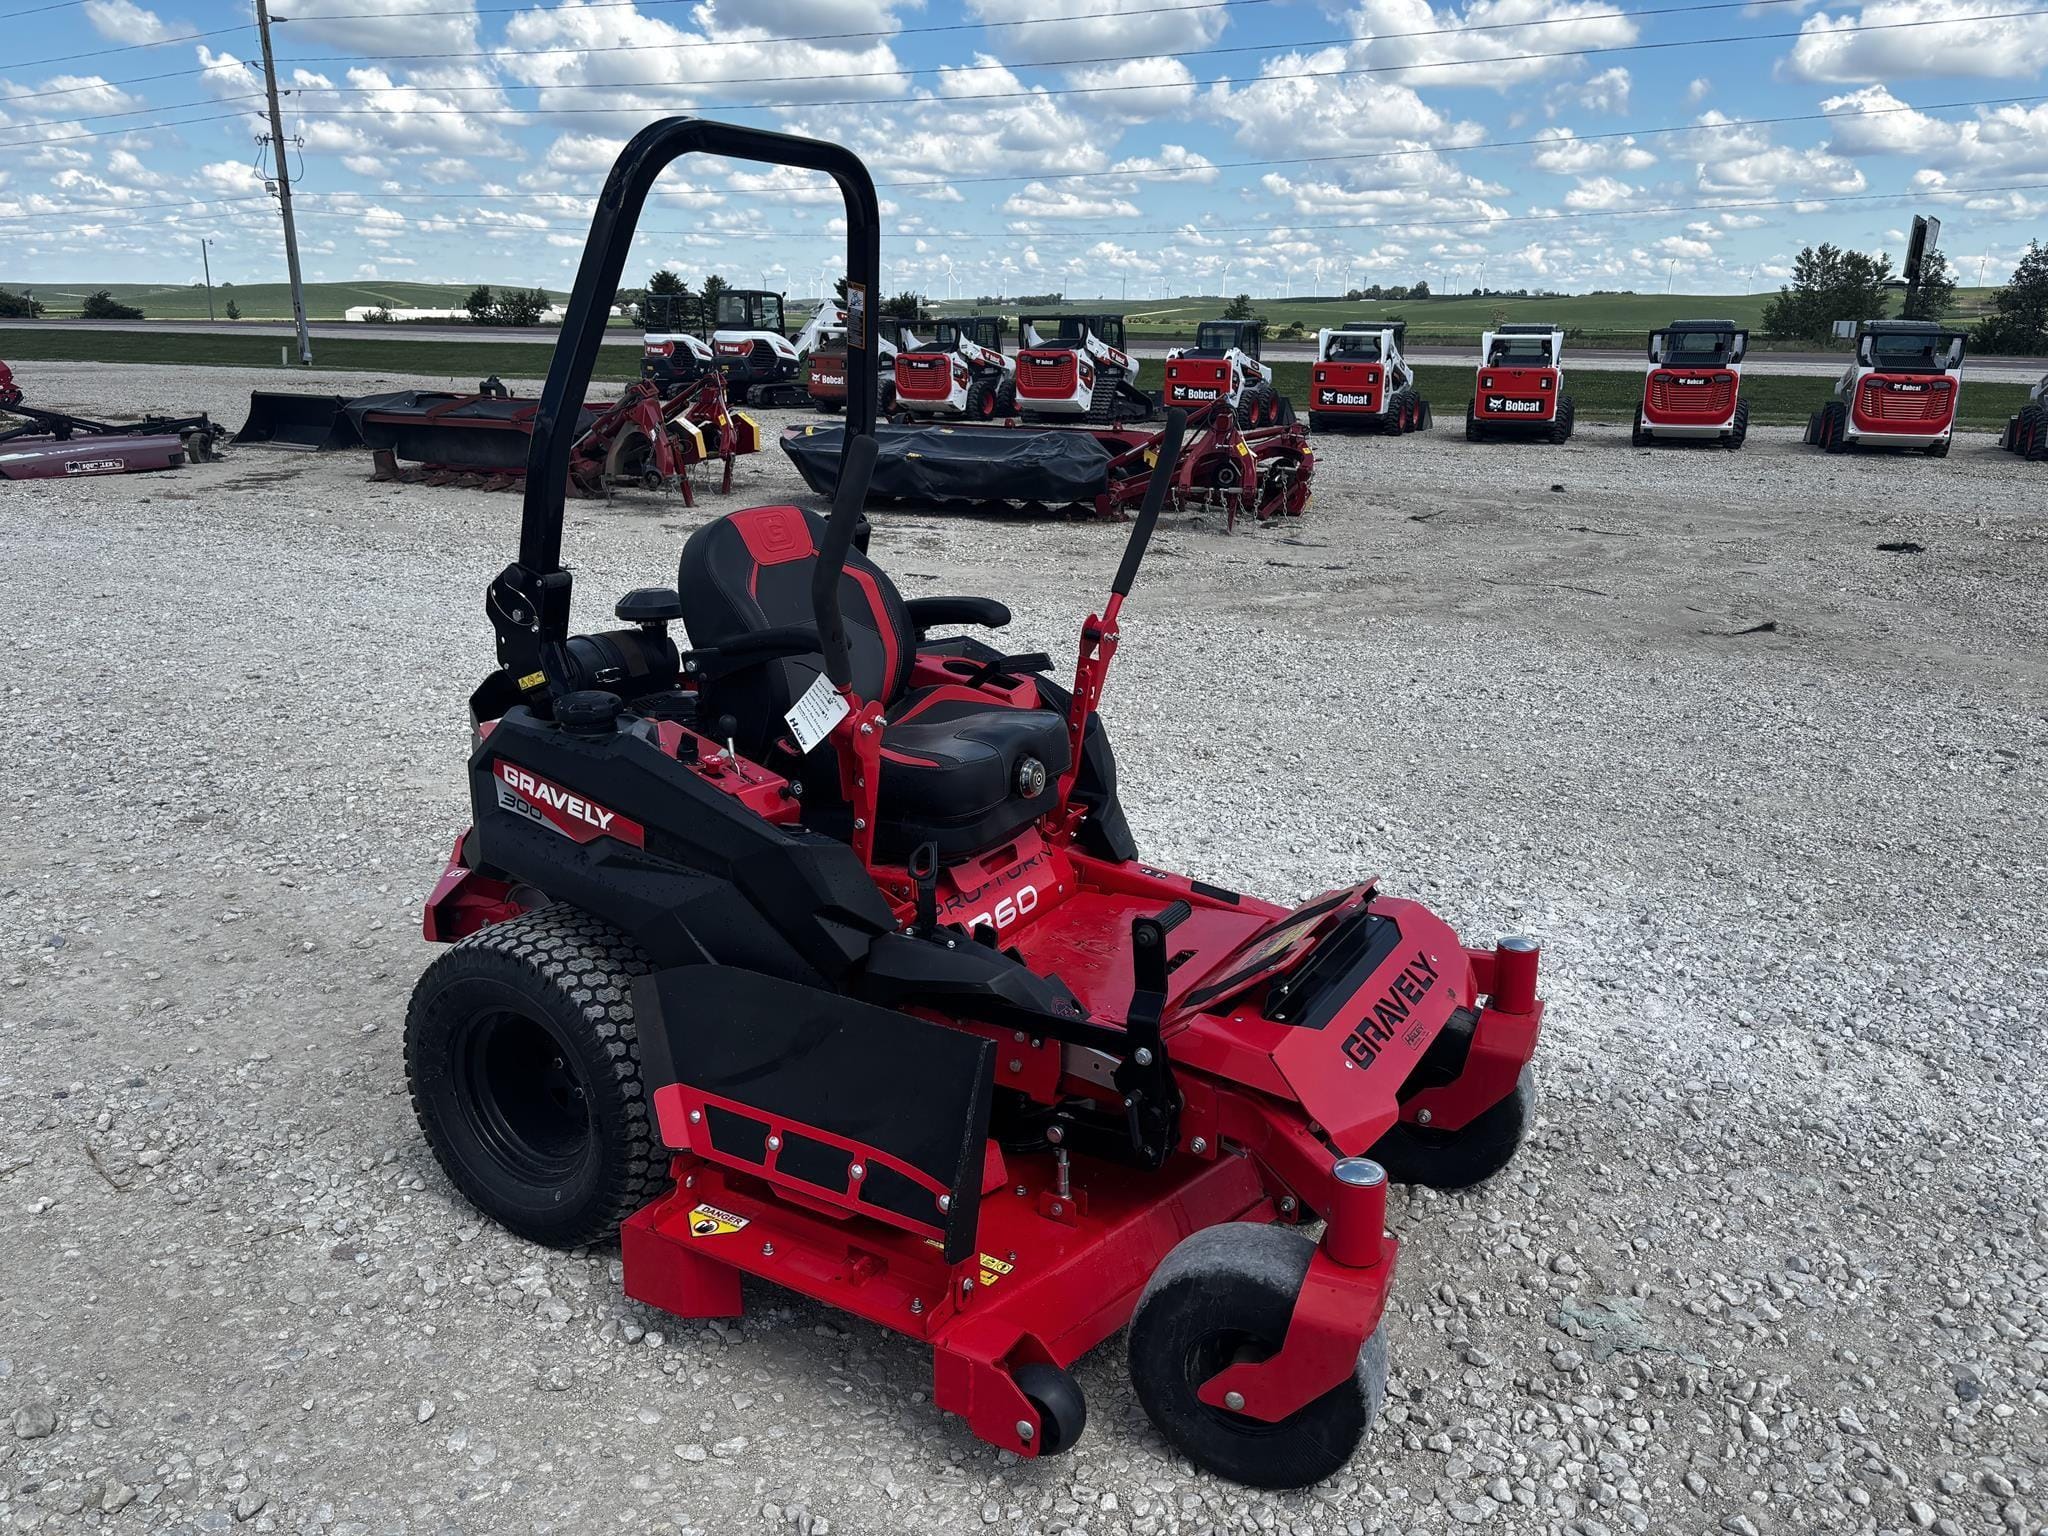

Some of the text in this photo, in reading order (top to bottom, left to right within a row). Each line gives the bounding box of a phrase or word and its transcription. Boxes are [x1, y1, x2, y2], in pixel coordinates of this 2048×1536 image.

[822, 375, 845, 385] Bobcat
[1188, 388, 1217, 400] Bobcat
[1336, 393, 1368, 405] Bobcat
[1505, 400, 1540, 412] Bobcat
[500, 791, 543, 820] 300
[503, 764, 615, 832] GRAVELY
[1341, 949, 1439, 1071] GRAVELY
[701, 1206, 743, 1226] DANGER
